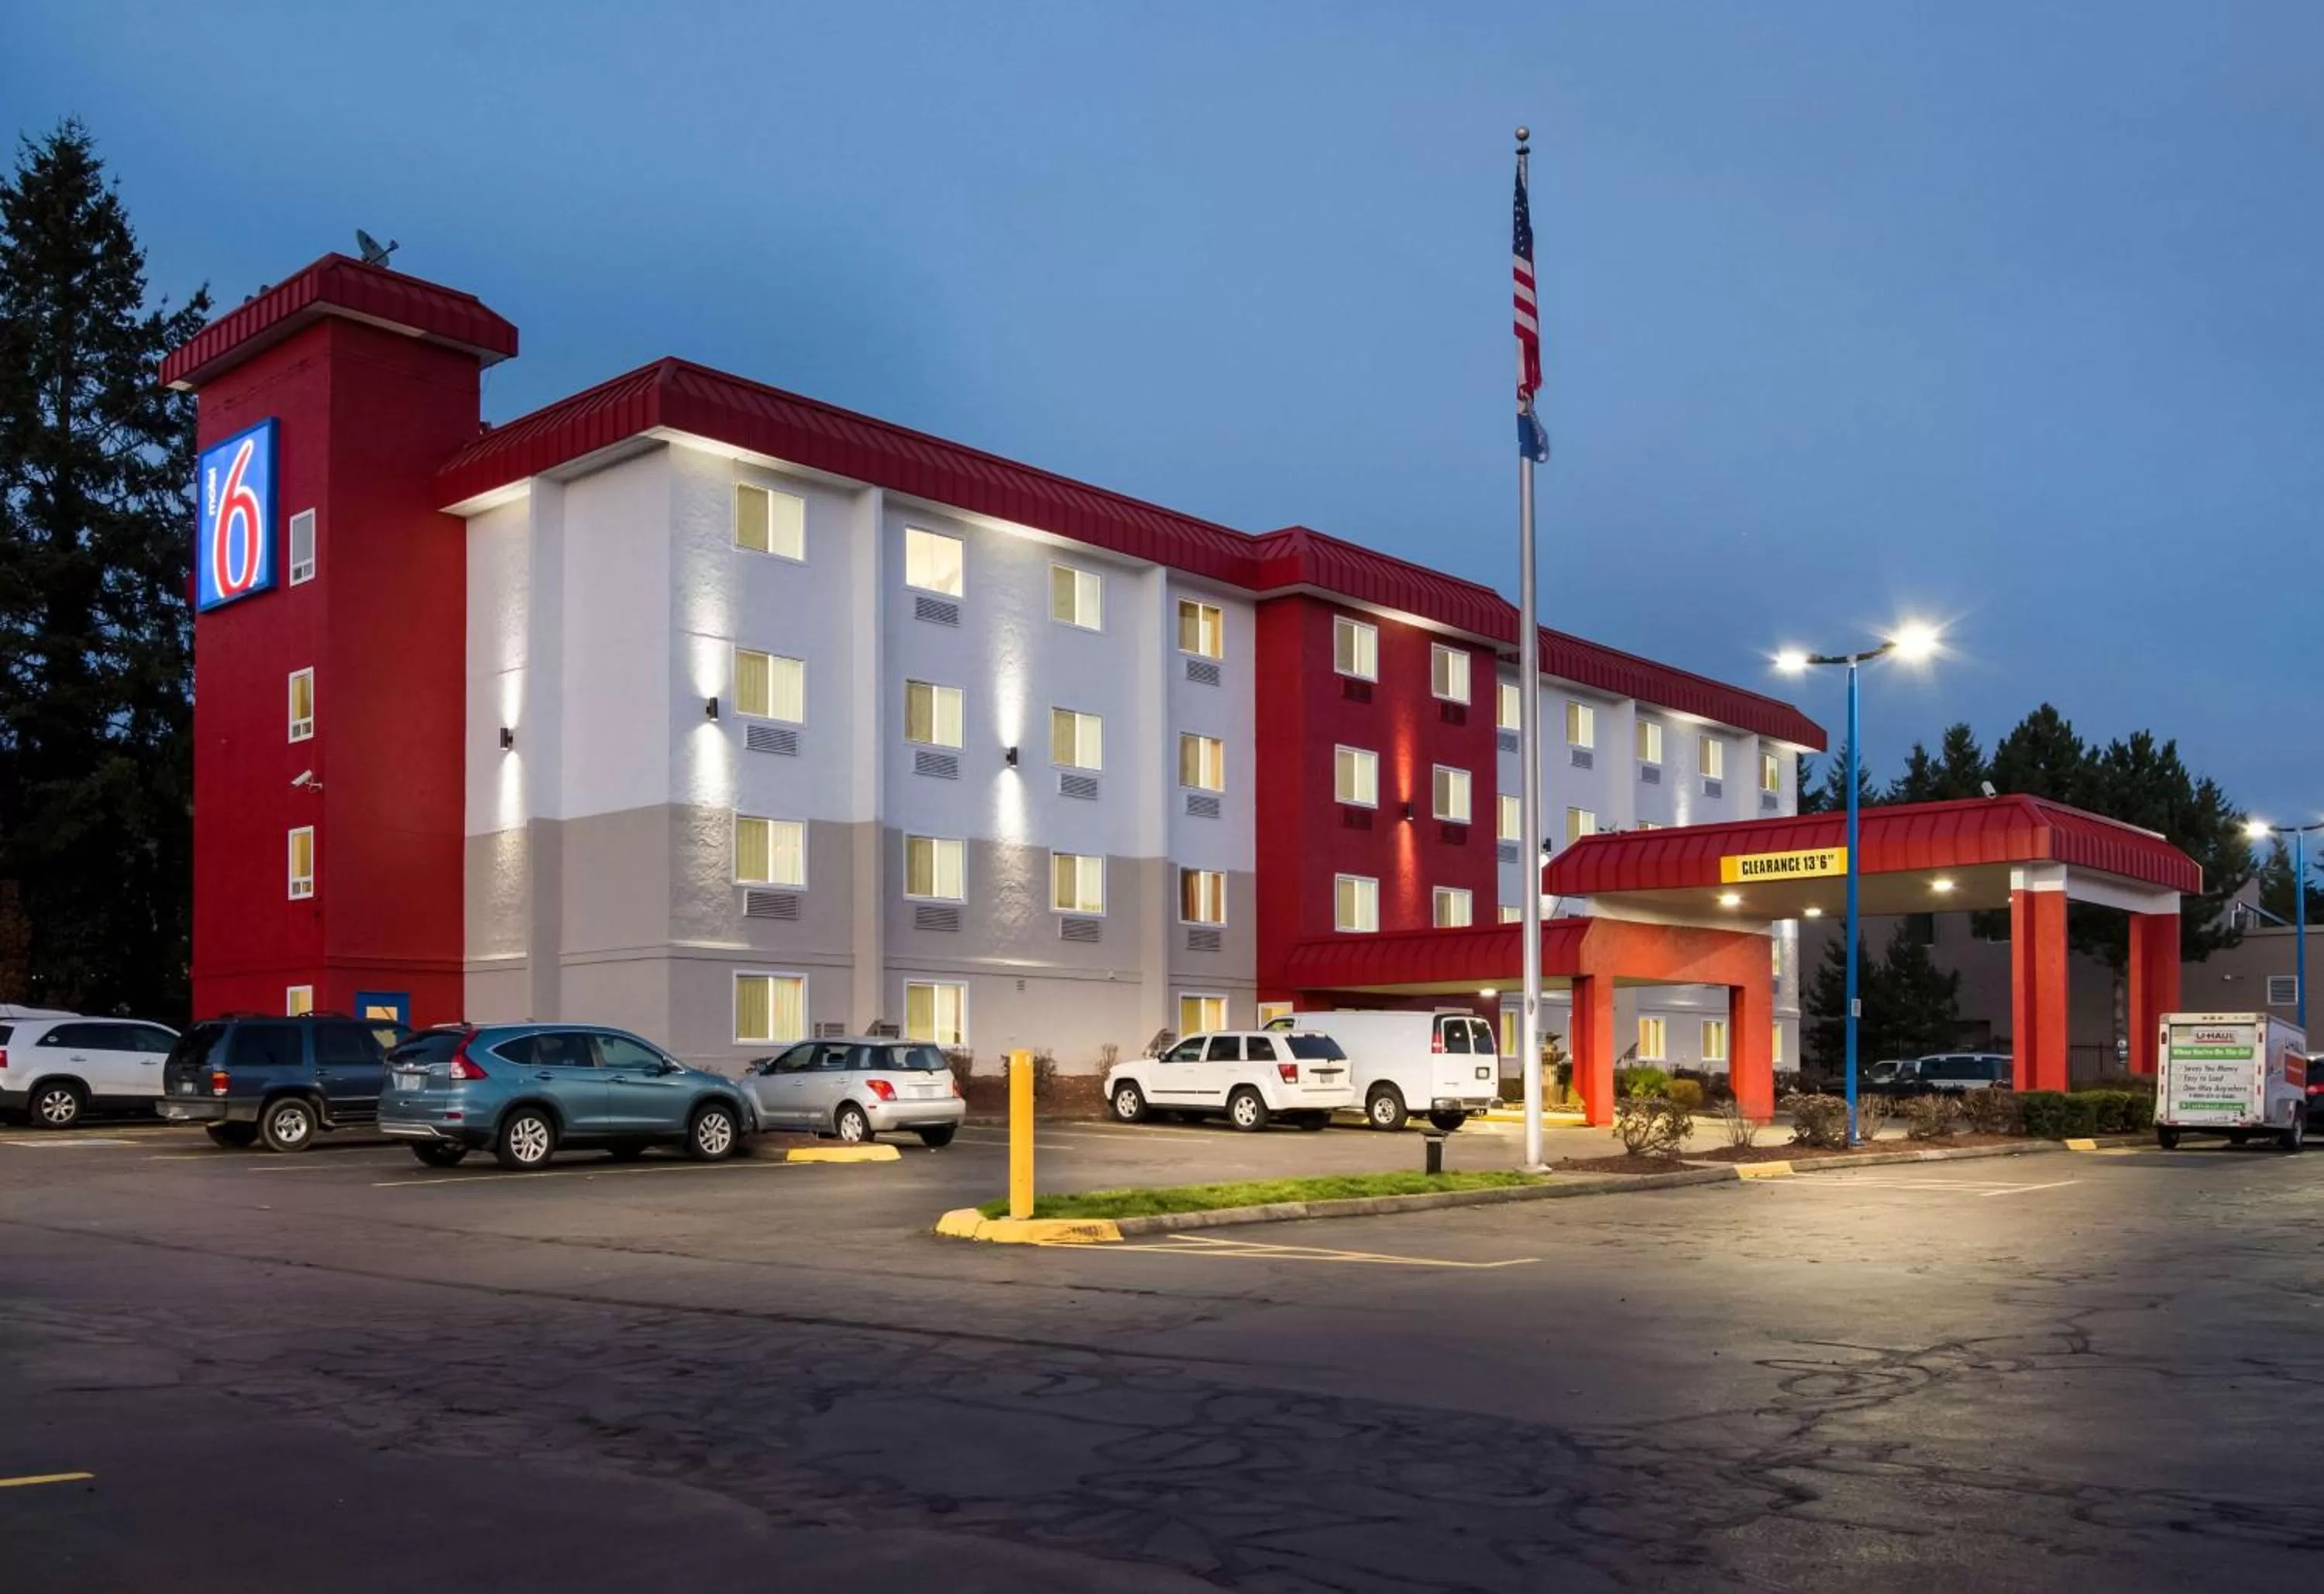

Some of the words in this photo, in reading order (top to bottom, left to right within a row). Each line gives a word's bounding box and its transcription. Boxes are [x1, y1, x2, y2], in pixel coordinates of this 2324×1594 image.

[208, 467, 217, 516] motel
[213, 439, 262, 598] 6
[1742, 858, 1800, 875] CLEARANCE
